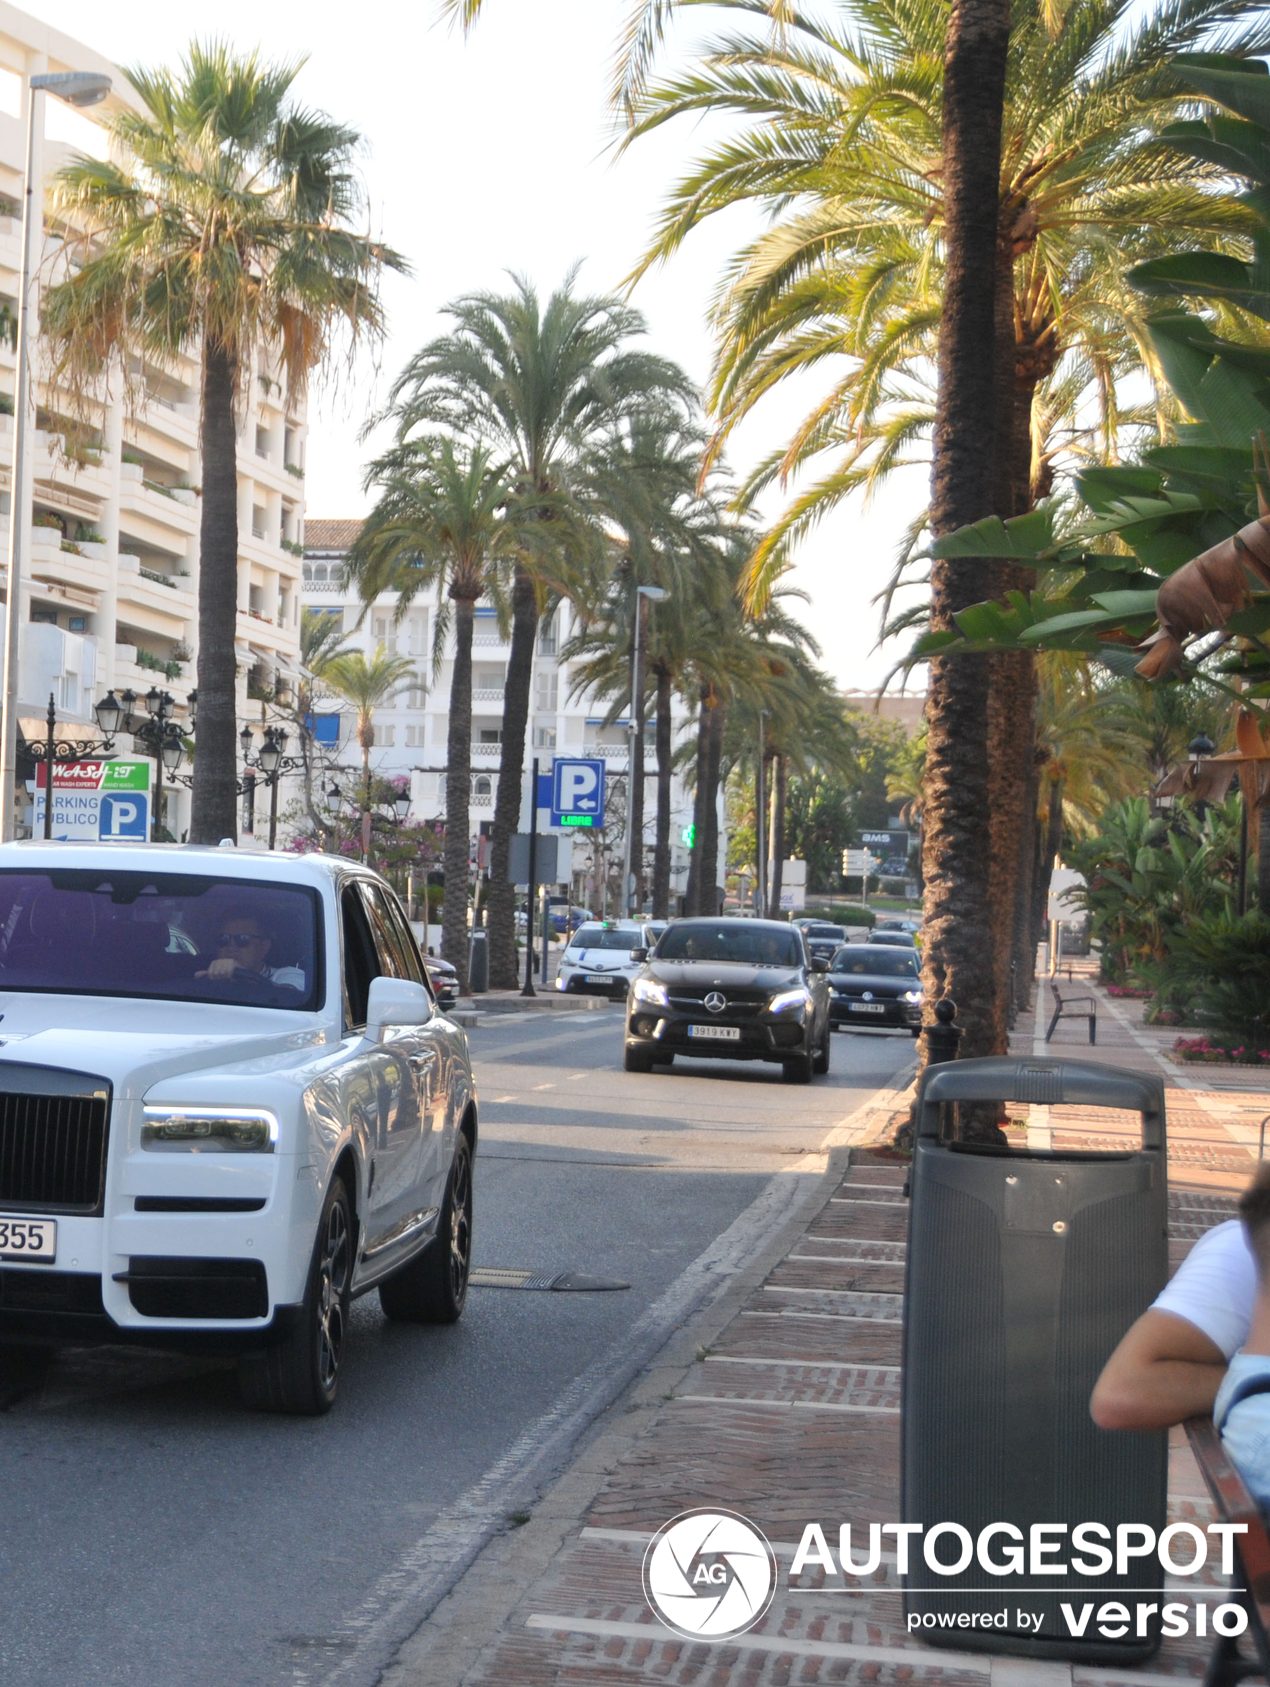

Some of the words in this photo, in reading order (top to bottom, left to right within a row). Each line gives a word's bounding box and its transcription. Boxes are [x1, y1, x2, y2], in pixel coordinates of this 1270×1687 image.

[560, 765, 597, 810] P
[37, 796, 98, 809] PRKING
[560, 815, 592, 827] LIBRE
[694, 1026, 718, 1037] 3919
